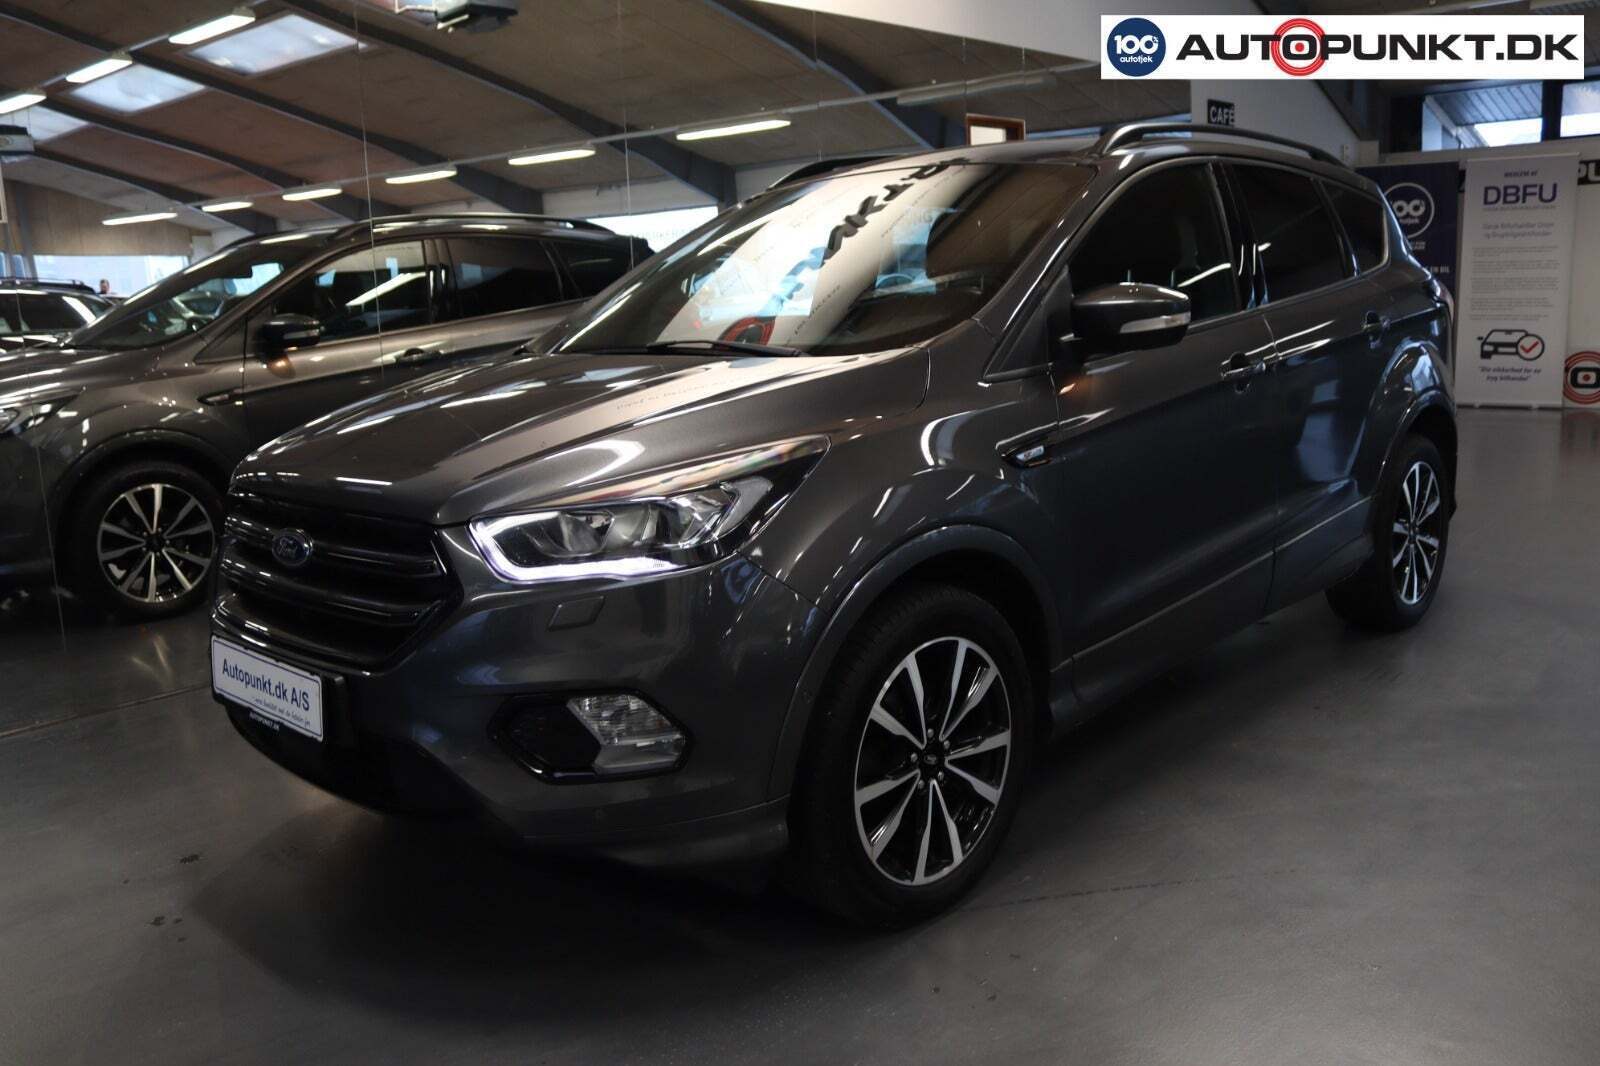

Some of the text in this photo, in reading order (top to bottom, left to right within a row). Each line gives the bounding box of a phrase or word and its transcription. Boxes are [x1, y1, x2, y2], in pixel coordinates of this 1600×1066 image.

[1483, 182, 1558, 205] DBFU
[222, 658, 289, 703] Autopunkt.dk
[290, 687, 311, 712] A/S
